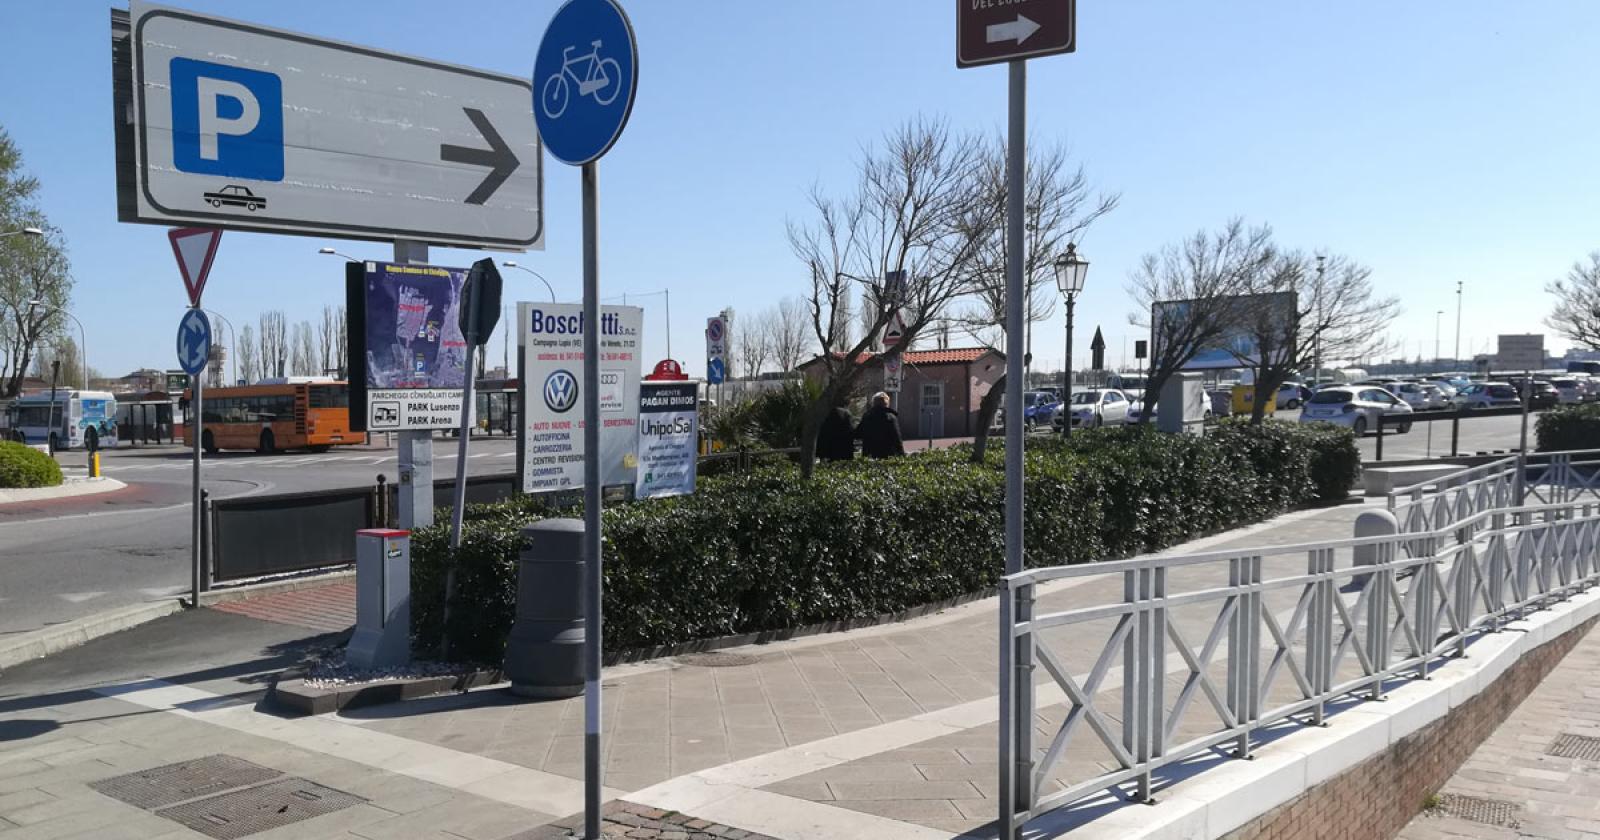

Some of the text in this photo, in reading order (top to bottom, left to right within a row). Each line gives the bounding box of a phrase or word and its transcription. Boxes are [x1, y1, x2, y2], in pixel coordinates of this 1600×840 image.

[197, 76, 261, 161] P
[655, 389, 681, 397] AGENTE
[641, 397, 669, 407] PAGAN
[407, 403, 460, 412] PARK Lusenzo
[407, 416, 453, 425] PARK Arena
[533, 422, 549, 430] AUTO
[551, 421, 572, 429] NUOVE
[533, 433, 570, 441] AUTOFFICINA
[532, 444, 572, 454] CARROZZERIA
[532, 456, 556, 465] CENTRO
[532, 467, 564, 477] GOMMISTA
[531, 478, 571, 488] IMPIANTI GPL
